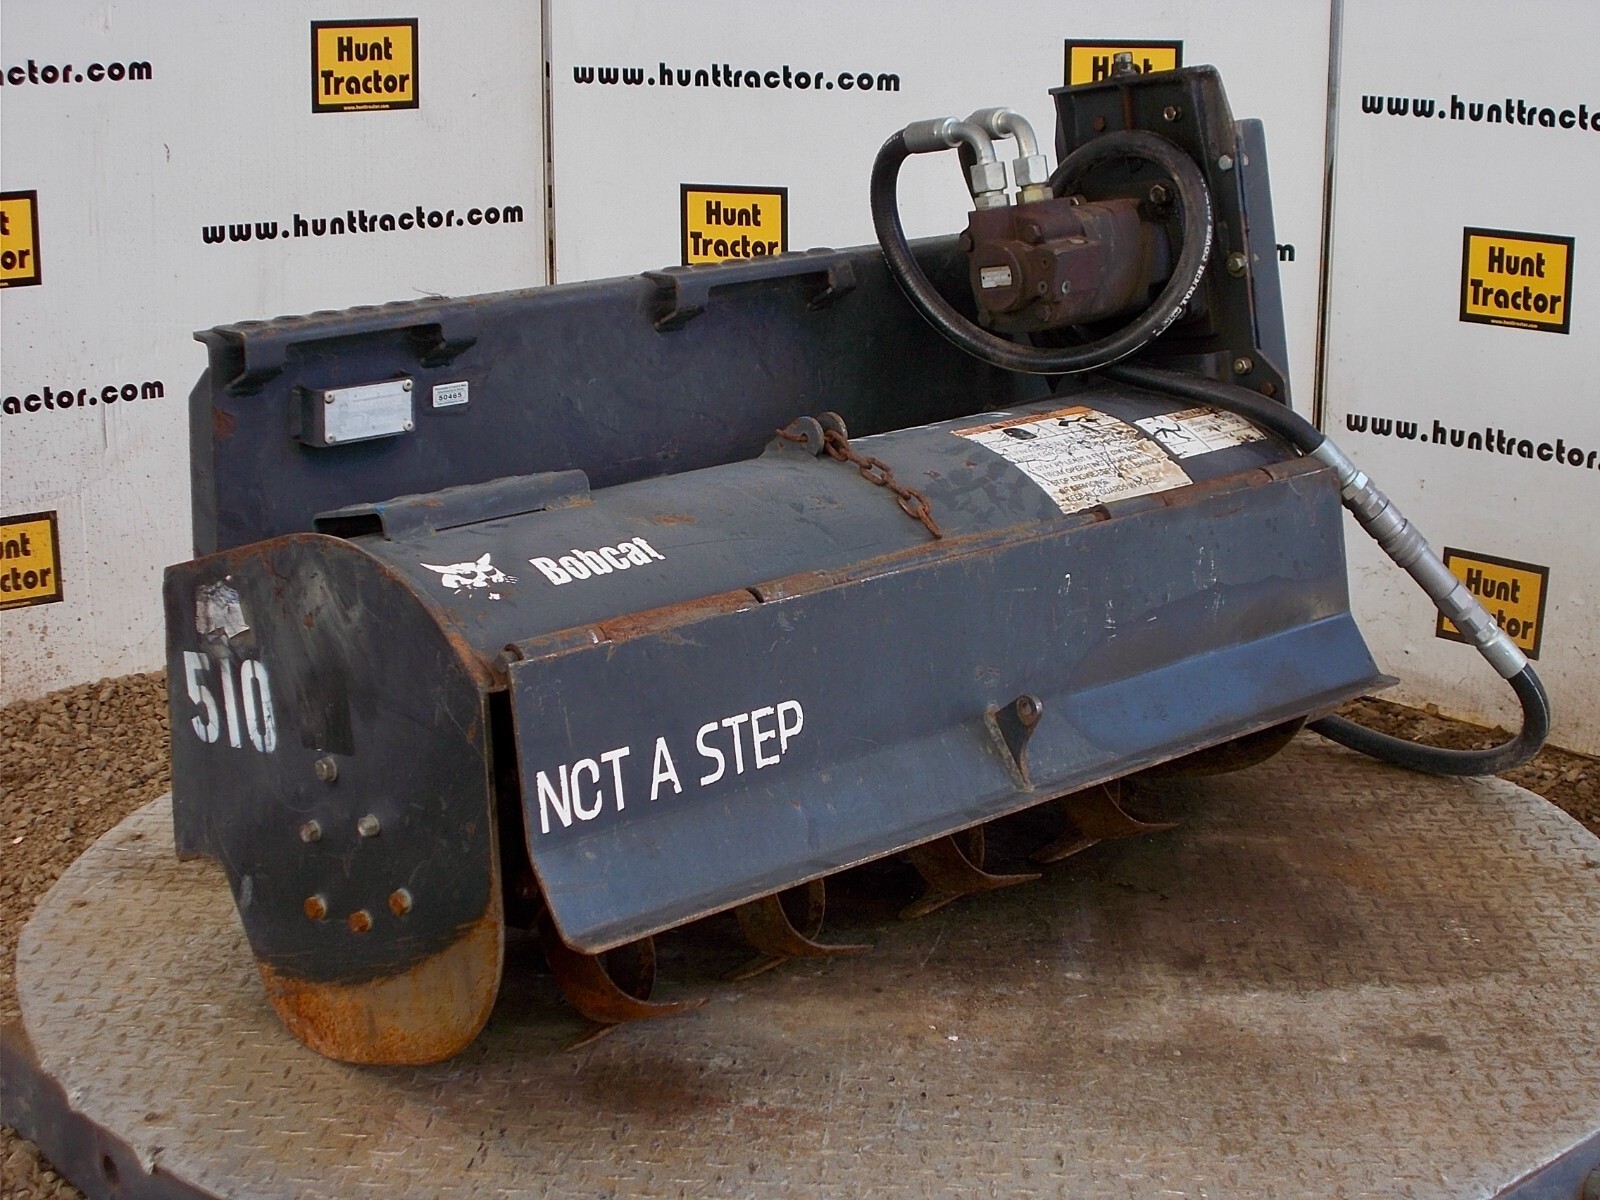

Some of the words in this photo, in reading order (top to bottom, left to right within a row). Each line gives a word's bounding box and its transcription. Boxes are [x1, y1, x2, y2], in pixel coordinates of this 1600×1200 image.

[337, 36, 393, 62] Hunt
[0, 60, 152, 86] ctor.com
[320, 69, 410, 95] Tractor
[573, 62, 901, 92] www.hunttractor.com
[202, 205, 524, 244] www.hunttractor.com
[705, 200, 762, 227] Hunt
[689, 231, 779, 258] Tractor
[1487, 246, 1546, 278] Hunt
[1470, 278, 1562, 315] Tractor
[2, 380, 165, 415] actor.com
[528, 536, 666, 586] Bobcat
[1466, 567, 1521, 604] Hunt
[183, 650, 277, 753] 510
[650, 736, 683, 801] A
[695, 699, 805, 787] STEP
